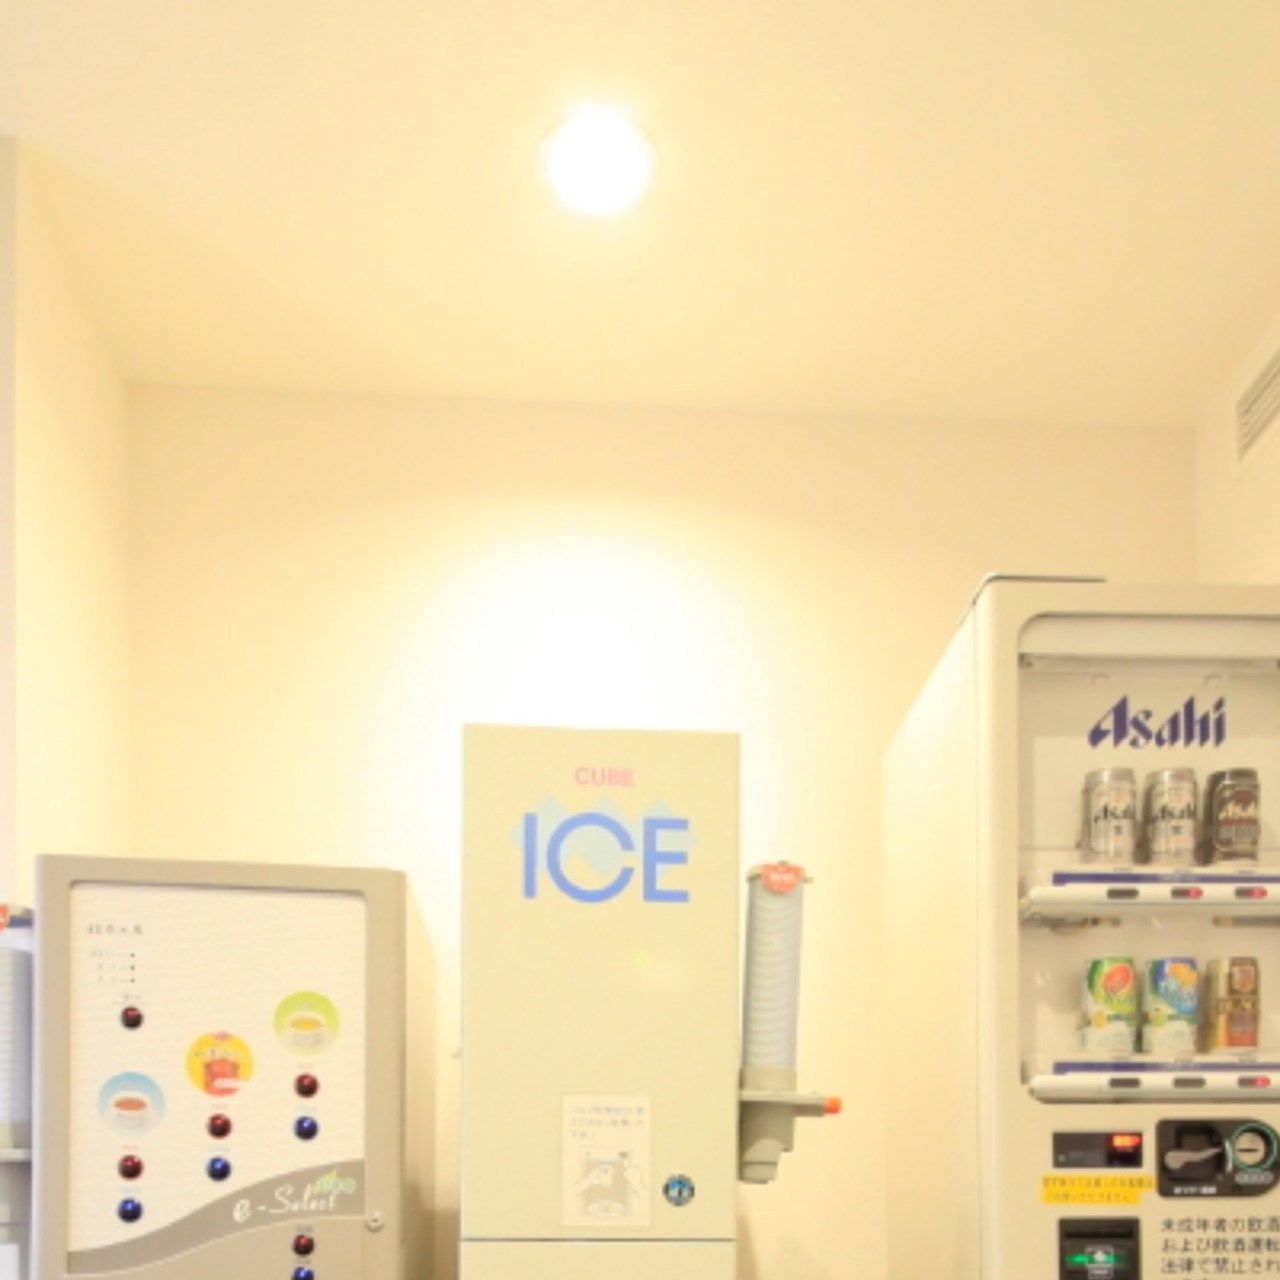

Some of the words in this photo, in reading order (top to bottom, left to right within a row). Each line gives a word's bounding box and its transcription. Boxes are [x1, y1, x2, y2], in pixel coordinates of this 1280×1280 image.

[1087, 694, 1227, 749] Asahi
[574, 767, 636, 788] CUBE
[523, 811, 690, 903] ICE
[1161, 1216, 1280, 1232] 未成年者の飲酒
